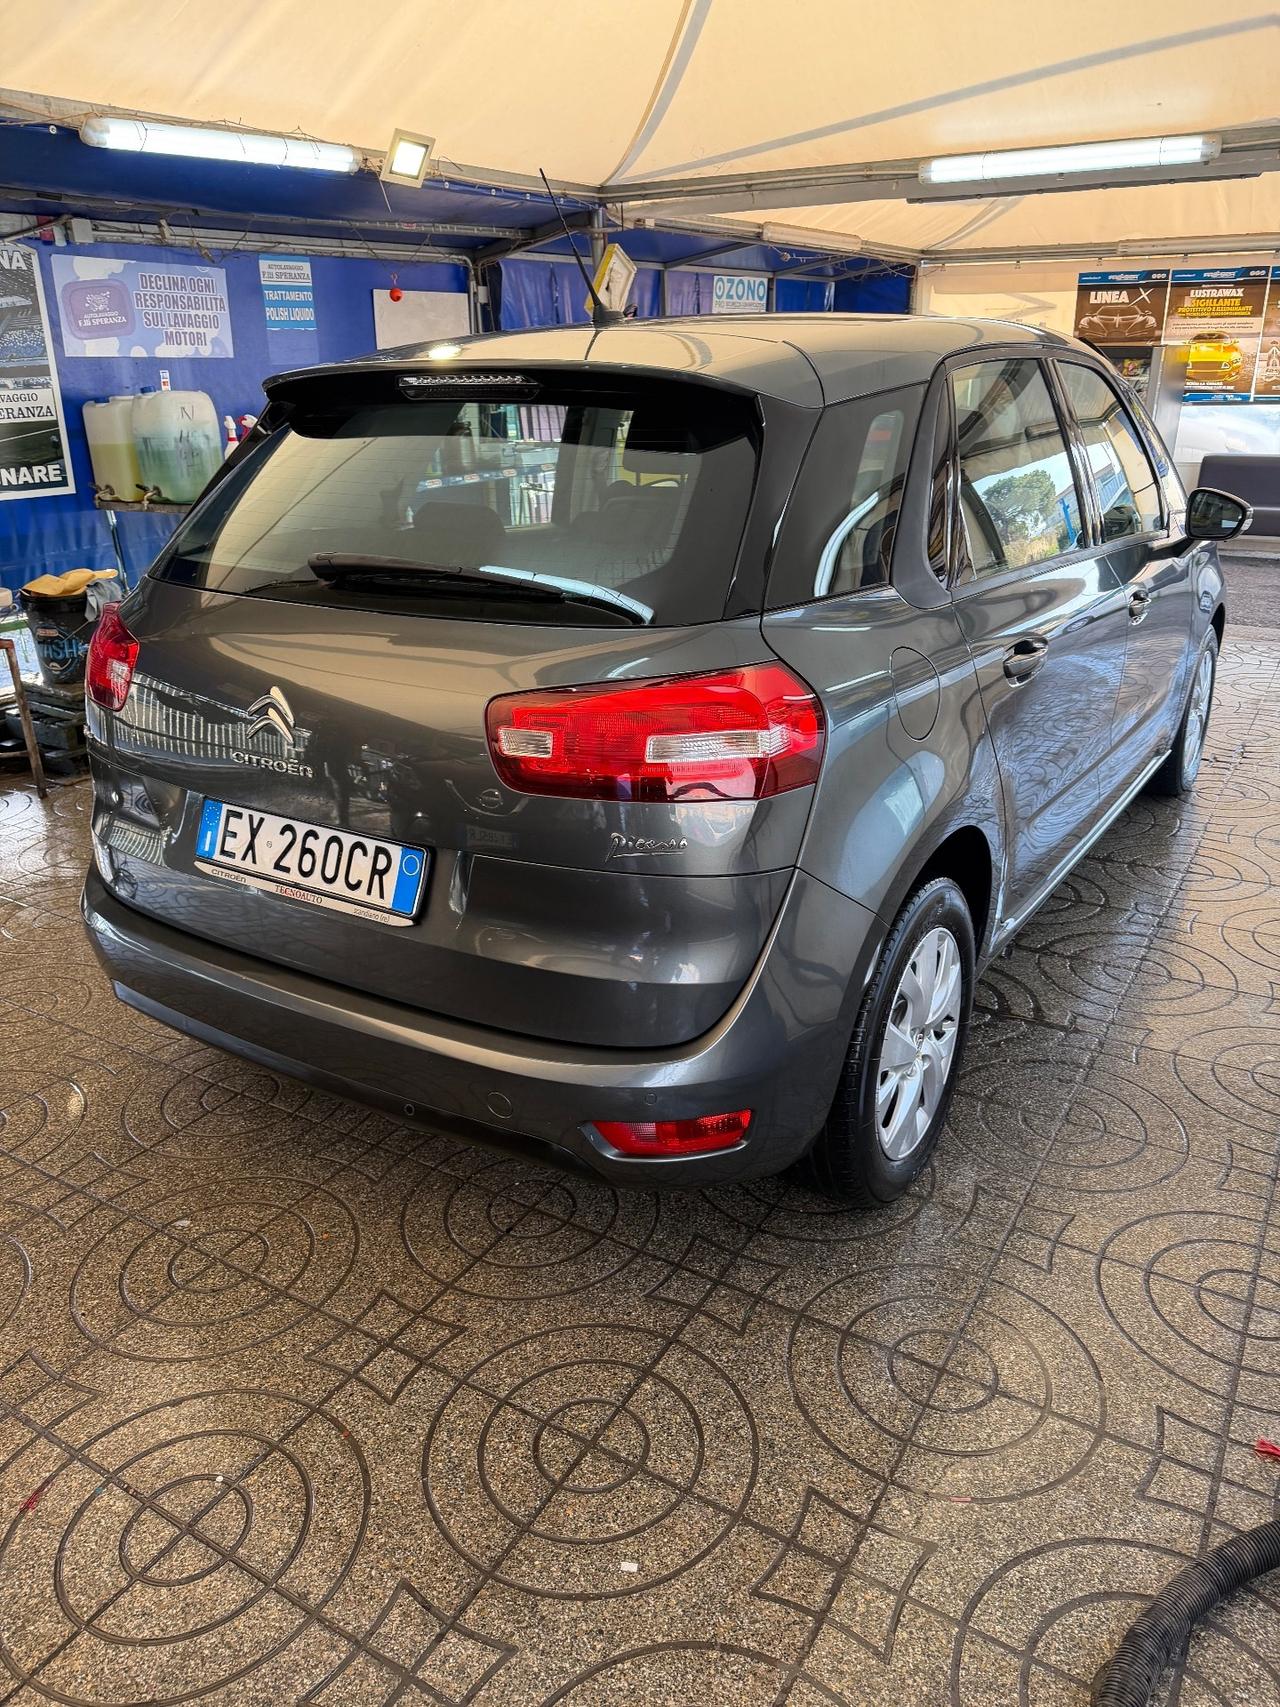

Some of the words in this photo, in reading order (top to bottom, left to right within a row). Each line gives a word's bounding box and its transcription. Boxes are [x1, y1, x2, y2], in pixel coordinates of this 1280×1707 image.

[139, 274, 187, 292] DECLINA
[189, 278, 216, 293] OGNI
[275, 272, 311, 280] SPERANZA
[264, 290, 313, 301] TRATTAMENTO
[715, 277, 766, 301] OZONO
[1089, 291, 1130, 304] LINEA
[1128, 287, 1154, 307] X
[1190, 288, 1245, 298] LUSTRAWAX
[134, 292, 226, 312] RESPONSABILITÀ
[1191, 298, 1242, 307] SIGILLANTE
[92, 316, 127, 326] SPERANZA
[143, 311, 166, 327] SUL
[167, 312, 220, 329] LAVAGGIO
[265, 307, 289, 320] POLISH
[290, 307, 315, 321] LIQUIDO
[164, 331, 207, 346] MOTORI
[0, 464, 62, 486] NARE
[231, 751, 314, 779] CITROËN
[219, 809, 265, 865] EX
[273, 823, 393, 900] 260CR
[604, 832, 688, 864] Picasso
[275, 884, 323, 905] TECNOAUTO
